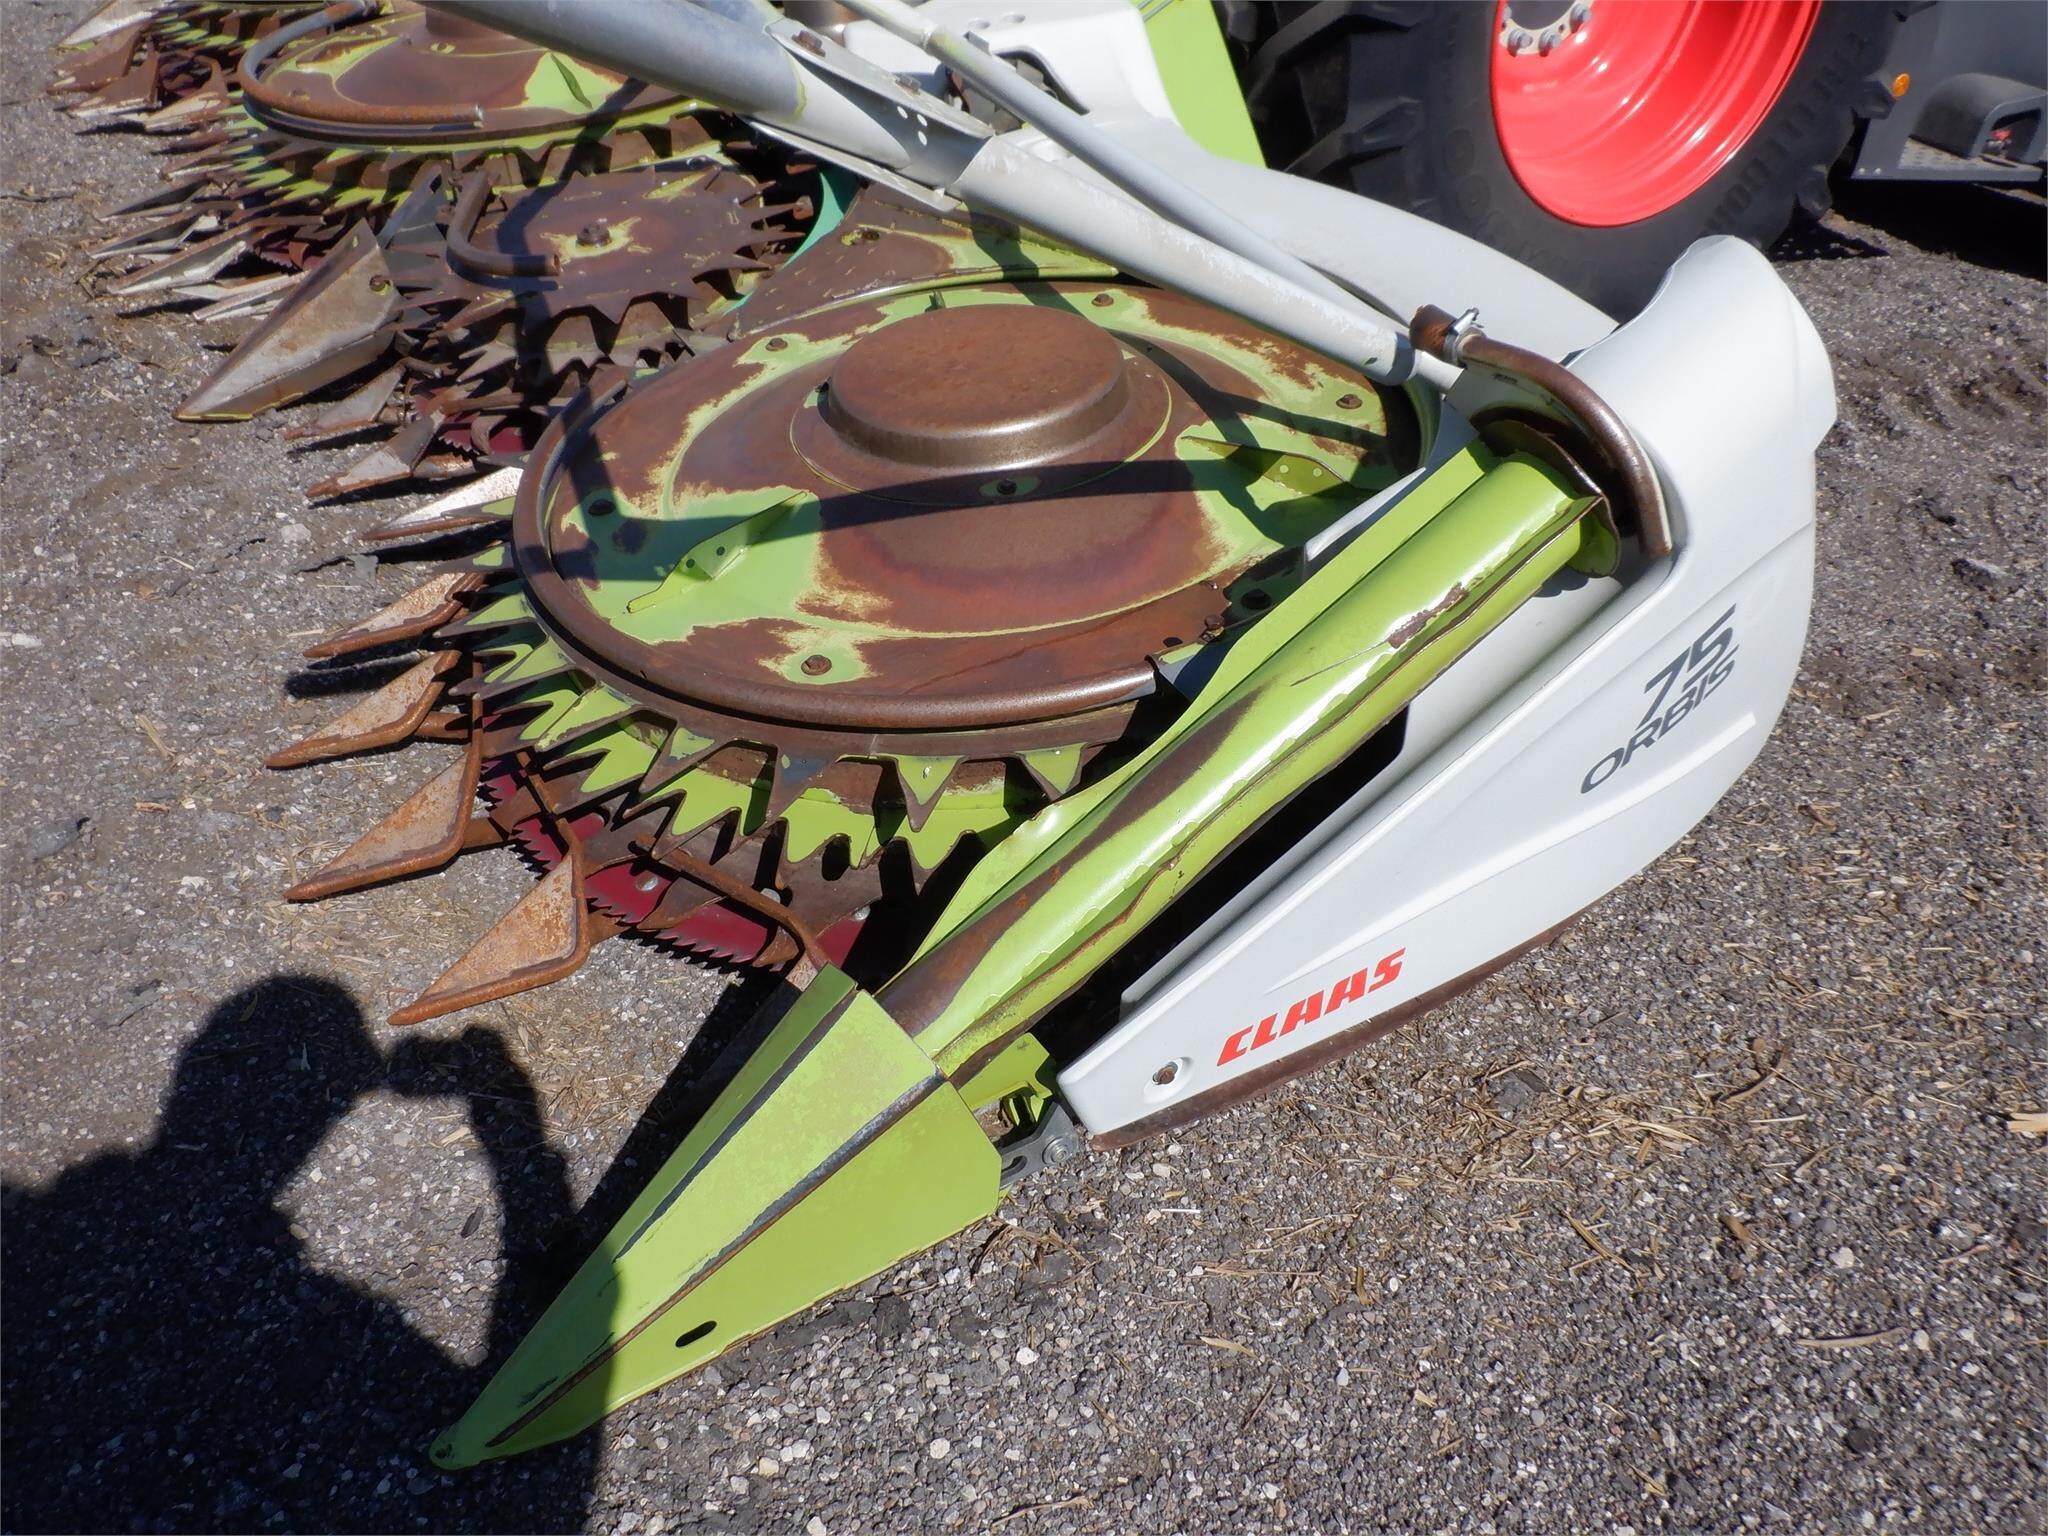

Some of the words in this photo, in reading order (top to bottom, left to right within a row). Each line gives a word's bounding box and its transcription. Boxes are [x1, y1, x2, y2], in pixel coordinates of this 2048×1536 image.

[1580, 644, 1740, 794] ORBIS
[1635, 603, 1737, 731] 75
[1216, 947, 1406, 1067] CLAAS
